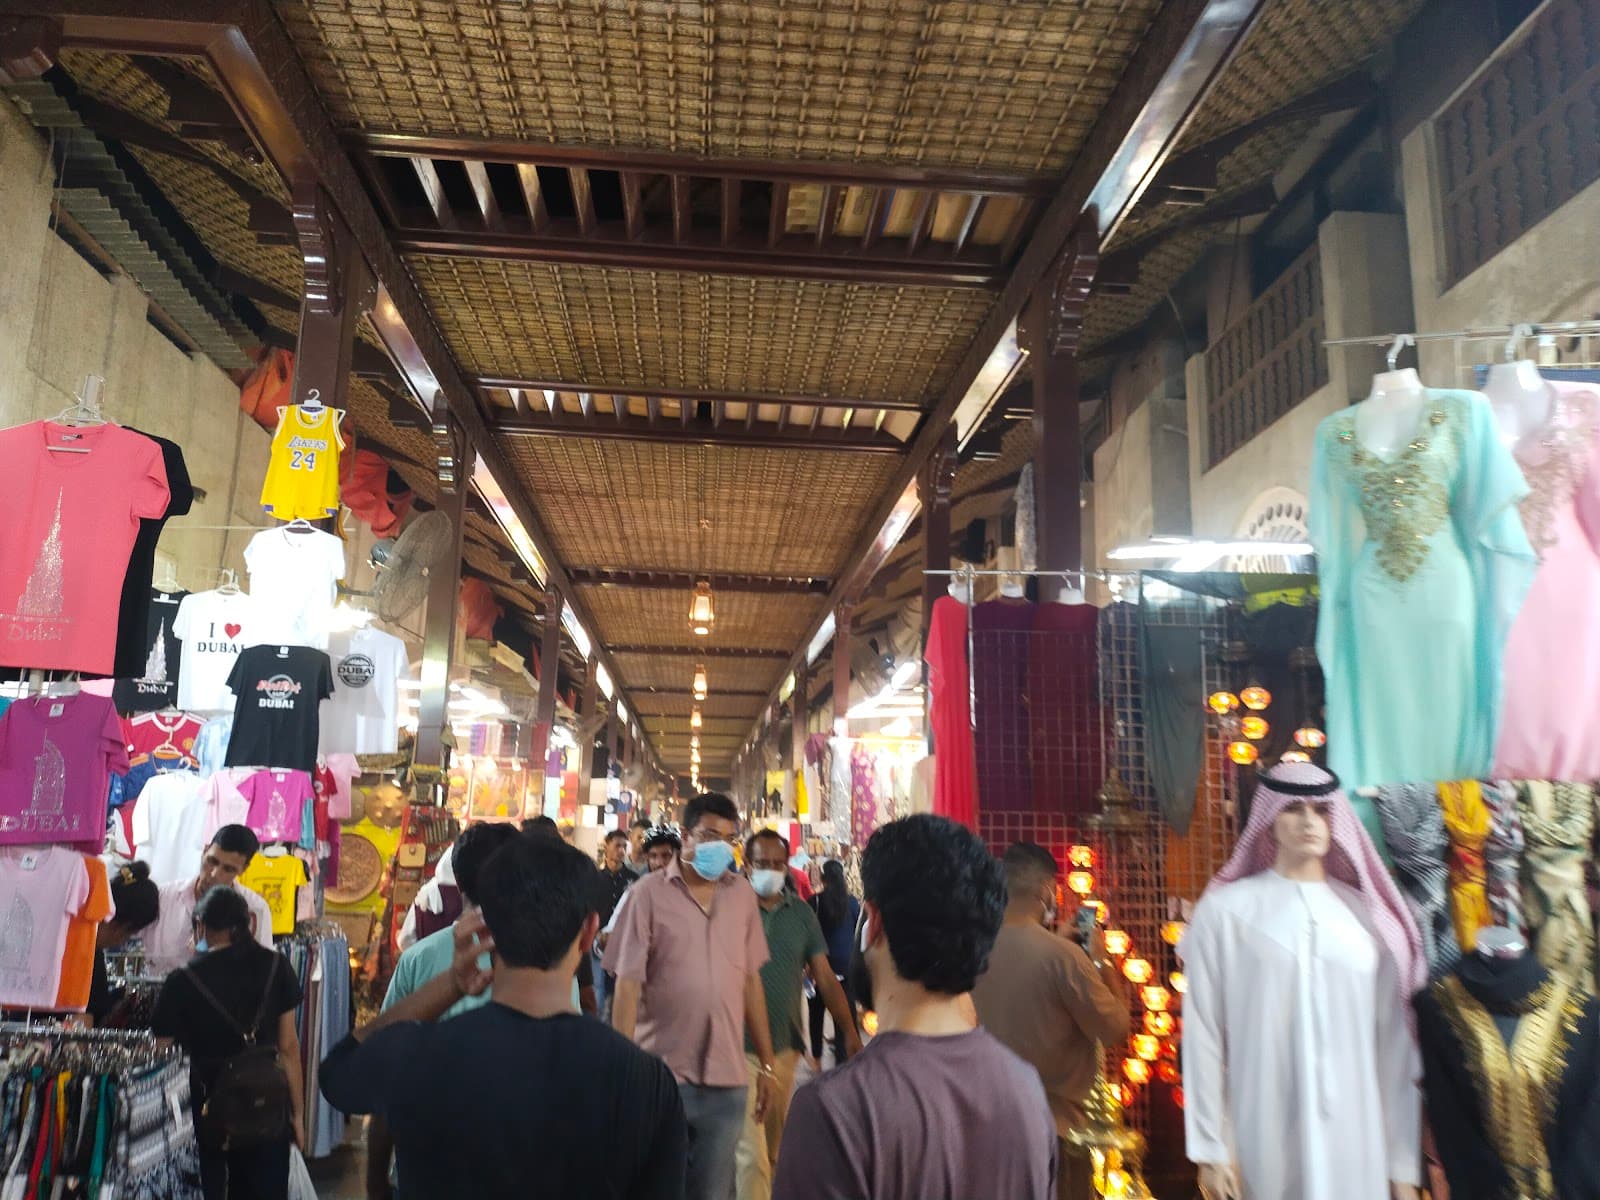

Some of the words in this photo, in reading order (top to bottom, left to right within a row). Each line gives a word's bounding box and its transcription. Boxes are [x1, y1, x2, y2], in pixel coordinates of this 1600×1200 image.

[290, 449, 316, 471] 24
[209, 622, 215, 638] I
[259, 698, 294, 709] DUBAI
